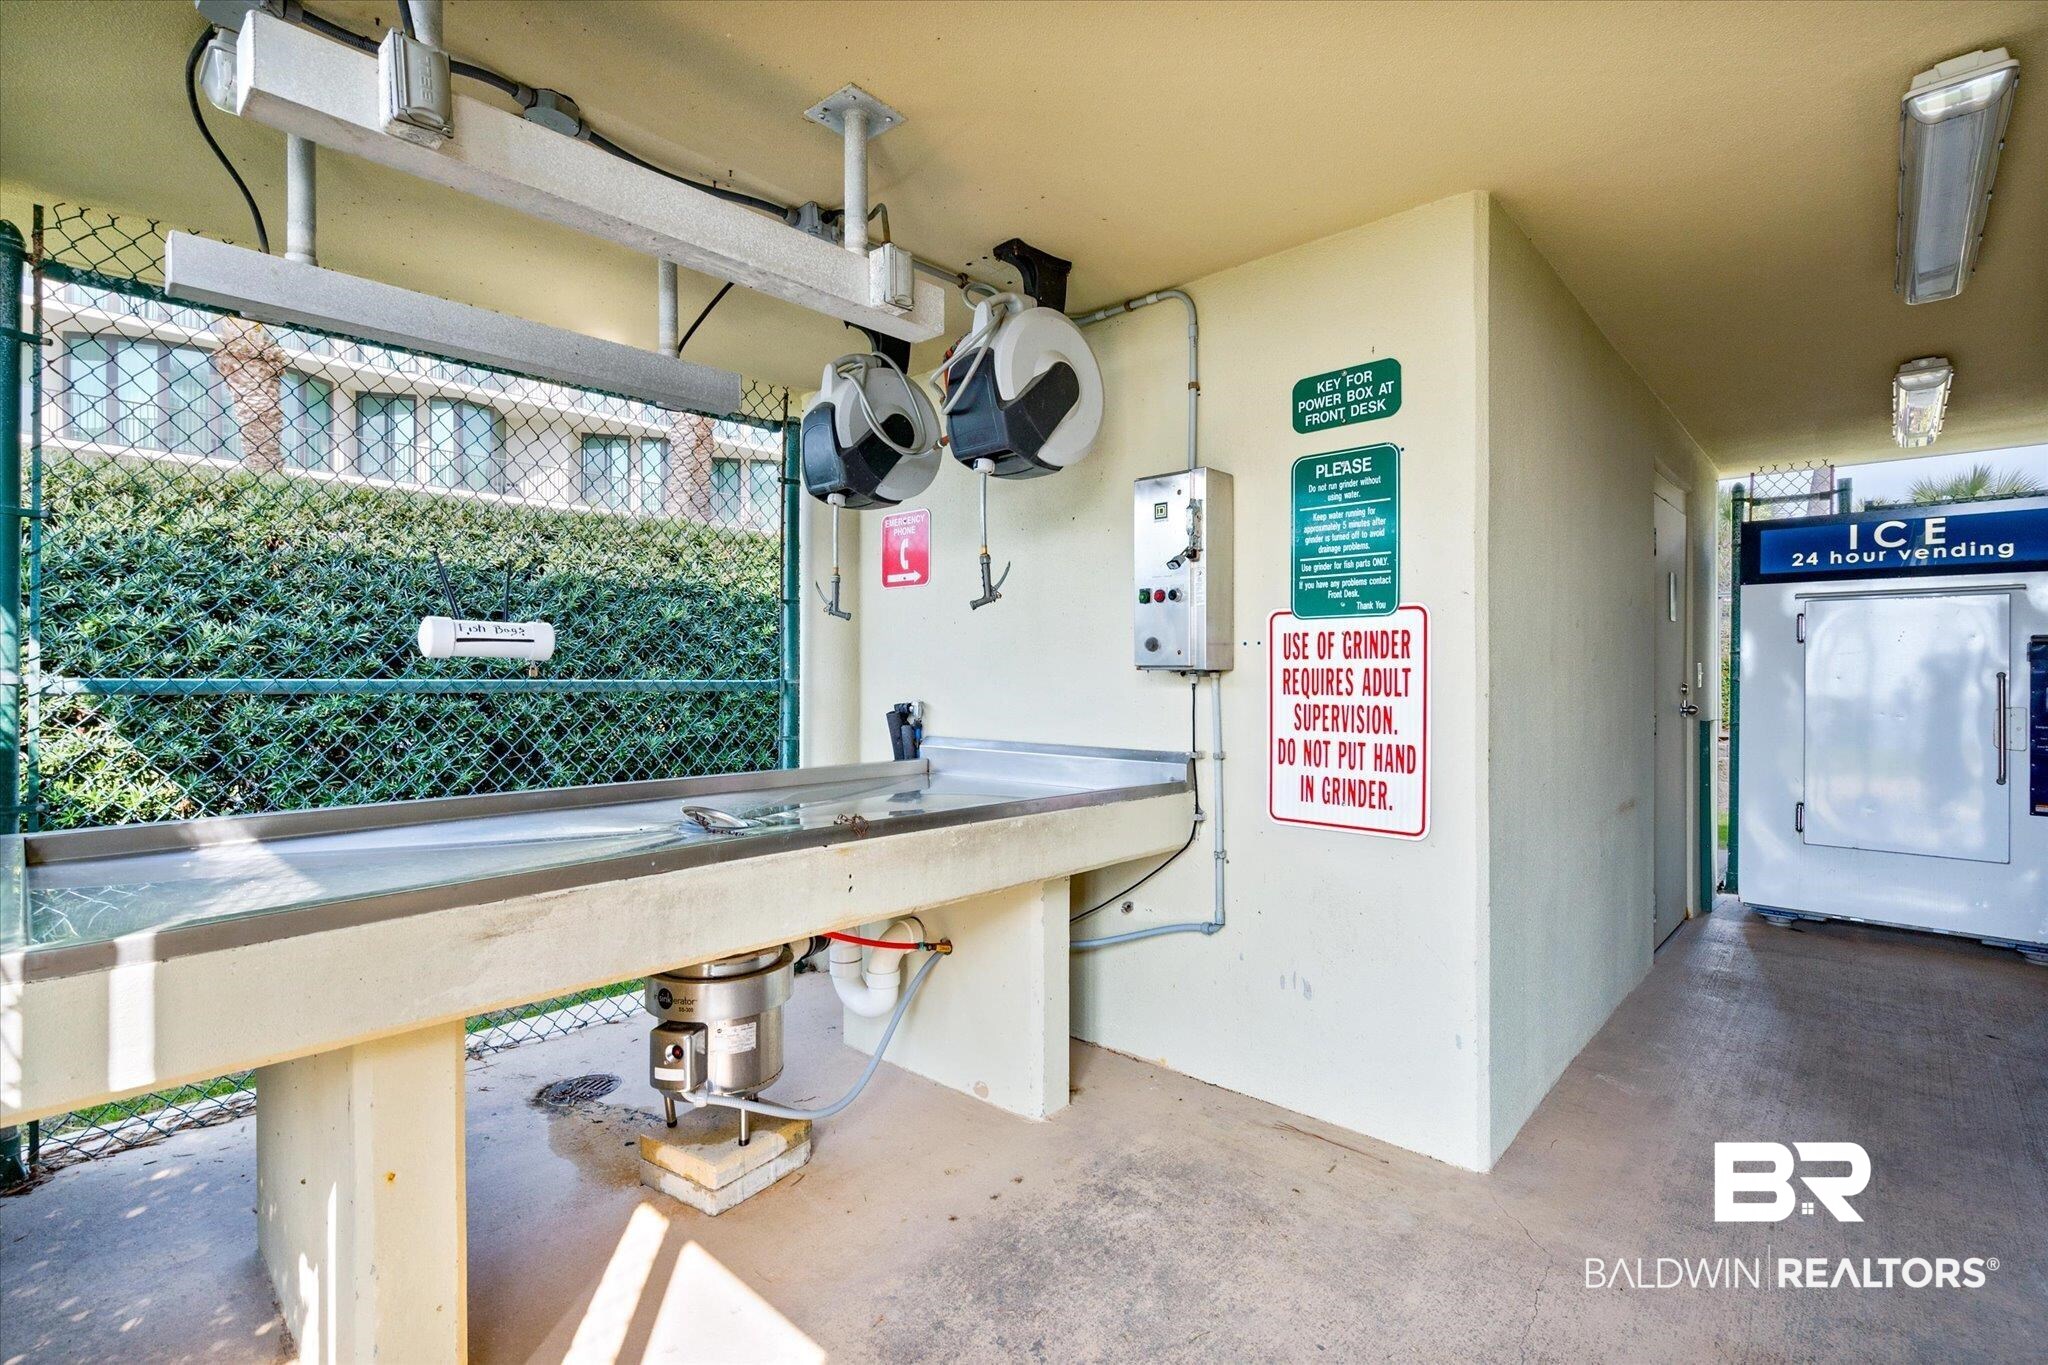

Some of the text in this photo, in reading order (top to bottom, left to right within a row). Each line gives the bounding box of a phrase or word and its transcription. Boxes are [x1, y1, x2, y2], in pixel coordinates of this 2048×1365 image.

[1317, 371, 1372, 393] KEY FOR
[1299, 381, 1394, 413] POWER BOX AT
[1305, 399, 1386, 426] FRONT DESK
[1315, 457, 1372, 478] PLEASE
[1309, 485, 1316, 493] Do
[1339, 479, 1358, 490] grinder
[1360, 476, 1381, 486] without
[1328, 491, 1360, 501] using water.
[885, 514, 925, 528] EMERGENCY
[1313, 507, 1376, 521] Keep water running for
[893, 526, 916, 536] PHONE
[1304, 517, 1386, 534] approximately 5 minutes after
[1850, 517, 1946, 549] ICE
[1305, 534, 1323, 545] grinder
[1332, 532, 1349, 541] turned
[1351, 531, 1359, 539] off
[1362, 530, 1367, 538] to
[1370, 528, 1385, 537] avoid
[1318, 542, 1370, 554] drainage problems.
[1792, 541, 2014, 566] 24 hour vending
[1301, 557, 1389, 573] Use grinder for fish parts ONLY.
[1299, 581, 1303, 589] If
[1305, 582, 1314, 591] you
[1316, 580, 1328, 588] have
[1342, 578, 1367, 588] problems
[1369, 576, 1391, 585] contact
[1328, 589, 1359, 598] Front Desk.
[1356, 601, 1386, 609] Thank You
[494, 625, 525, 636] Bags
[1283, 629, 1411, 660] USE OF GRINDER
[1283, 668, 1411, 699] REQUIRES ADULT
[1294, 704, 1398, 735] SUPERVISION.
[1278, 738, 1416, 774] DO NOT PUT HAND
[1301, 775, 1393, 811] IN GRINDER.
